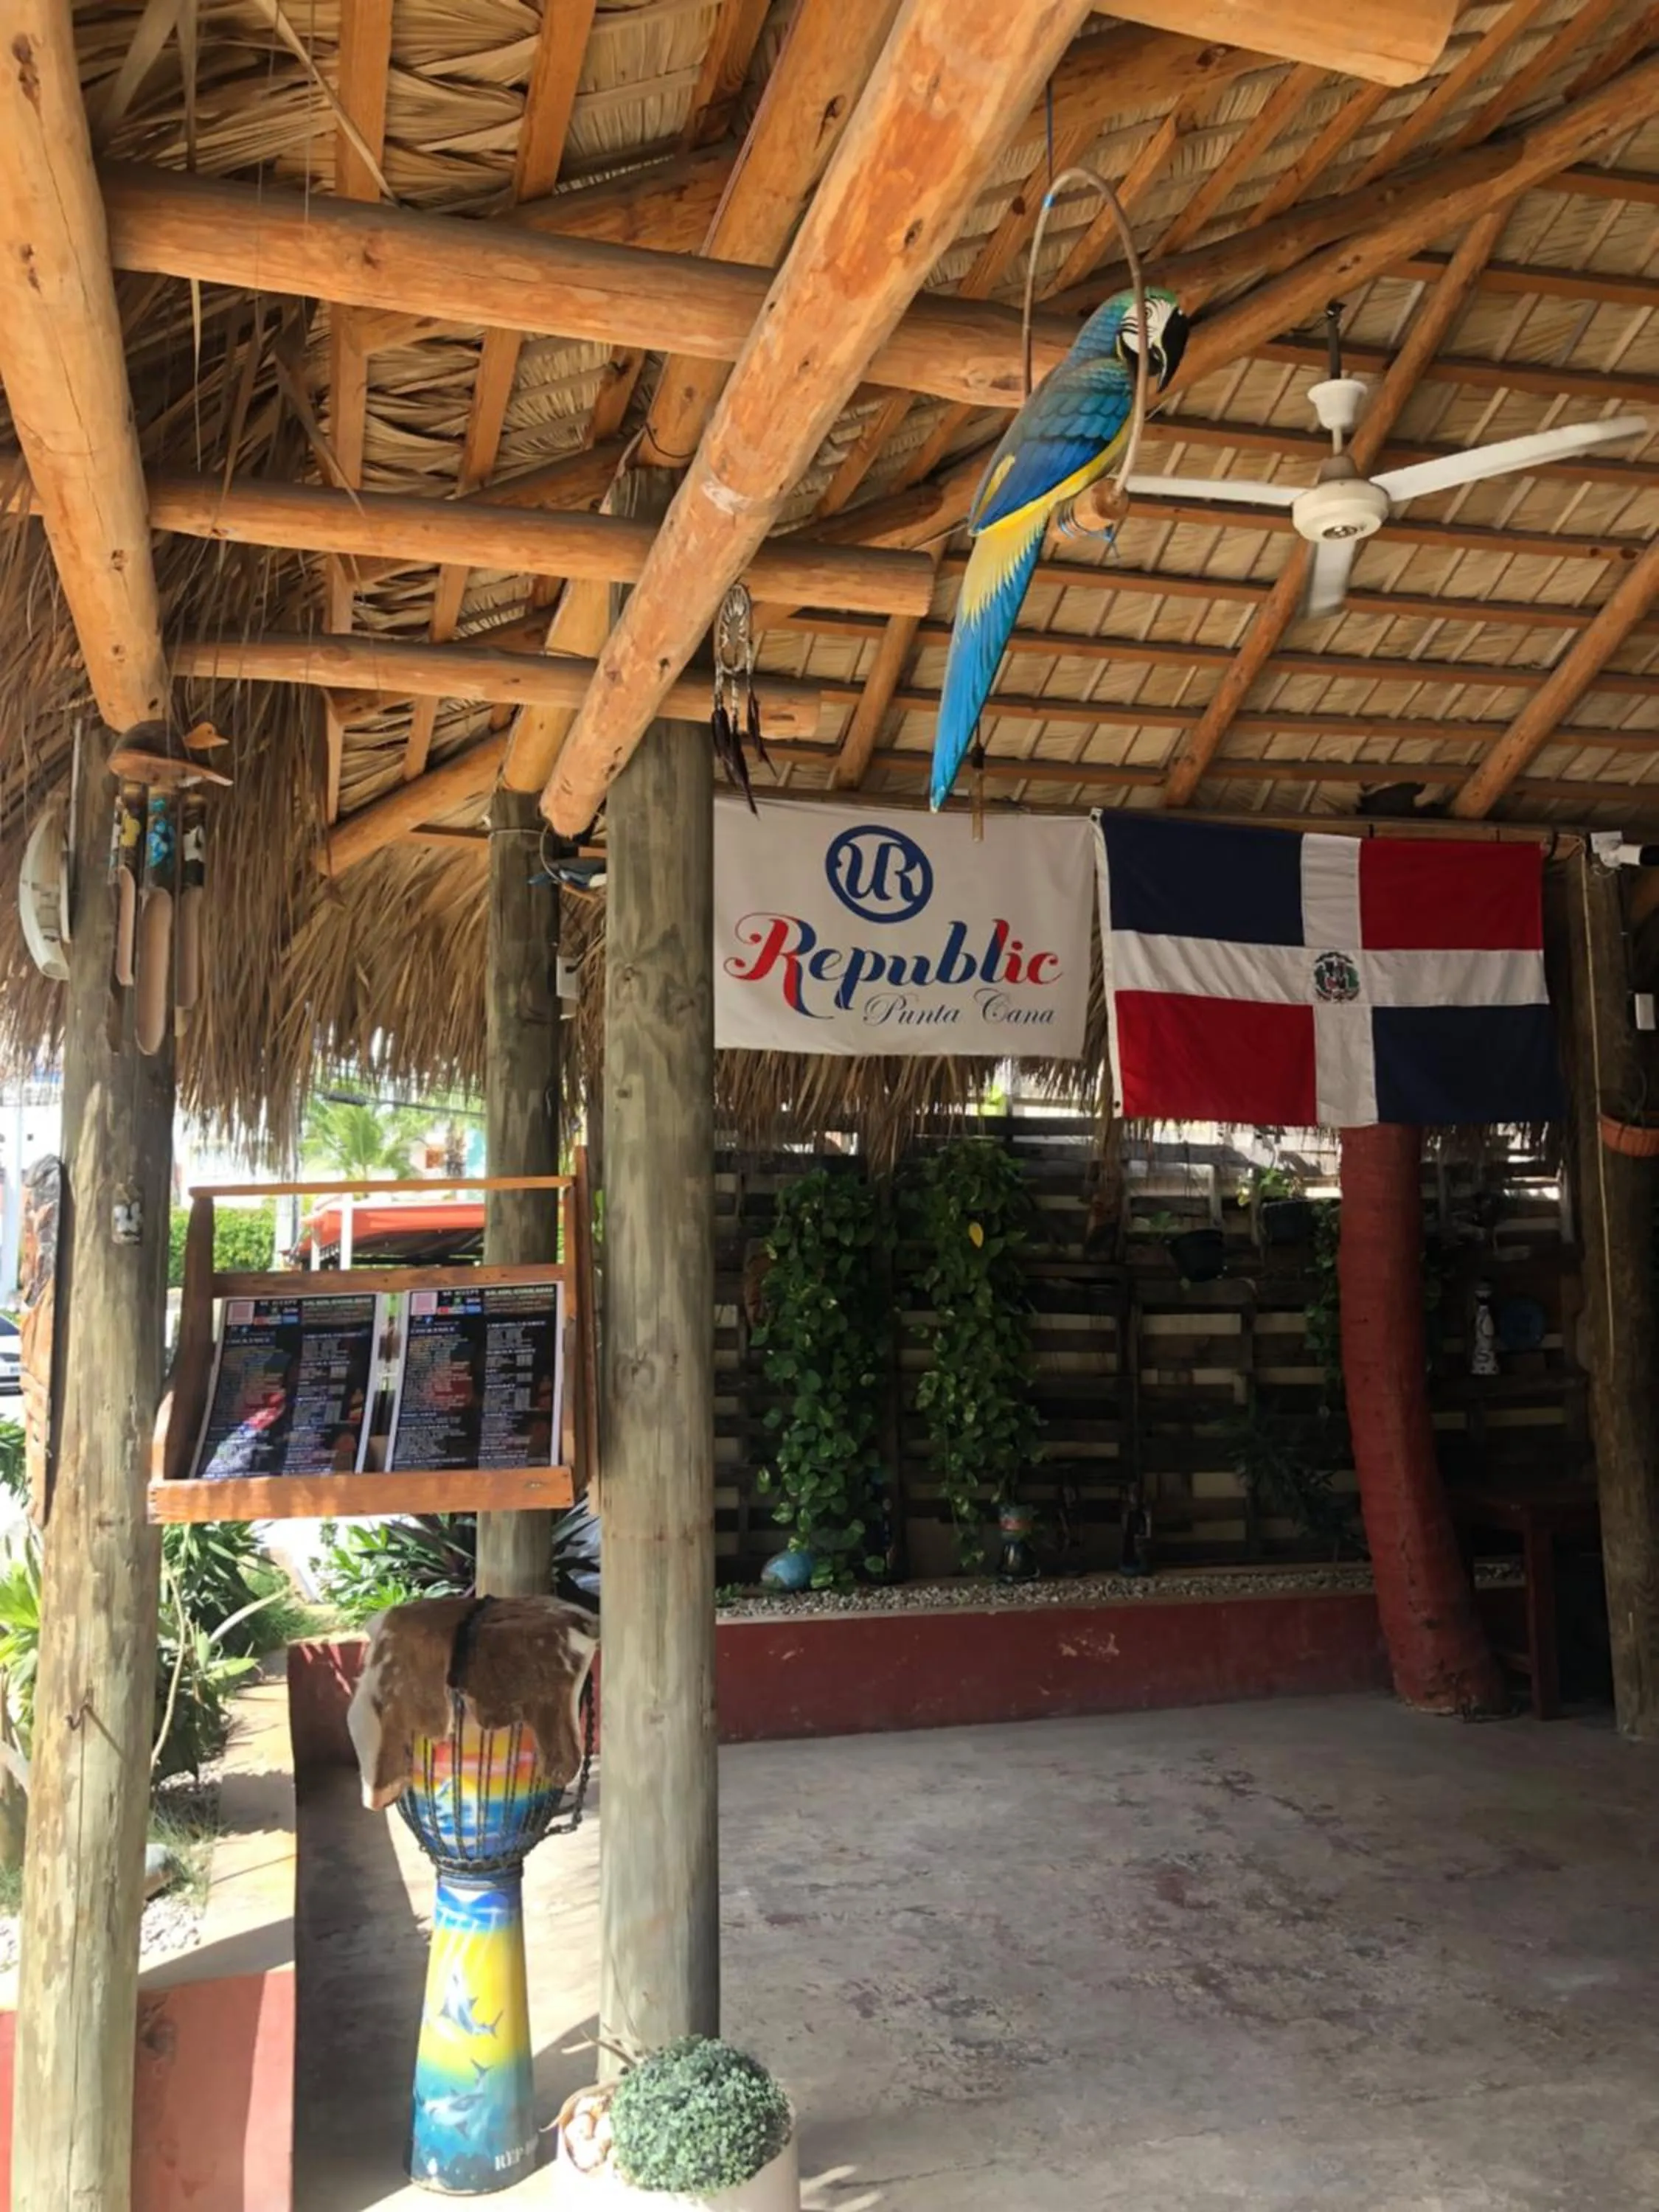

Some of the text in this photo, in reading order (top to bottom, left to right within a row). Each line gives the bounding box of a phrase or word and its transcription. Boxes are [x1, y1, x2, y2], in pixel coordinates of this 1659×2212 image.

[835, 841, 920, 901] UR
[723, 912, 1063, 1020] Republic
[863, 987, 1054, 1026] Punta Cana
